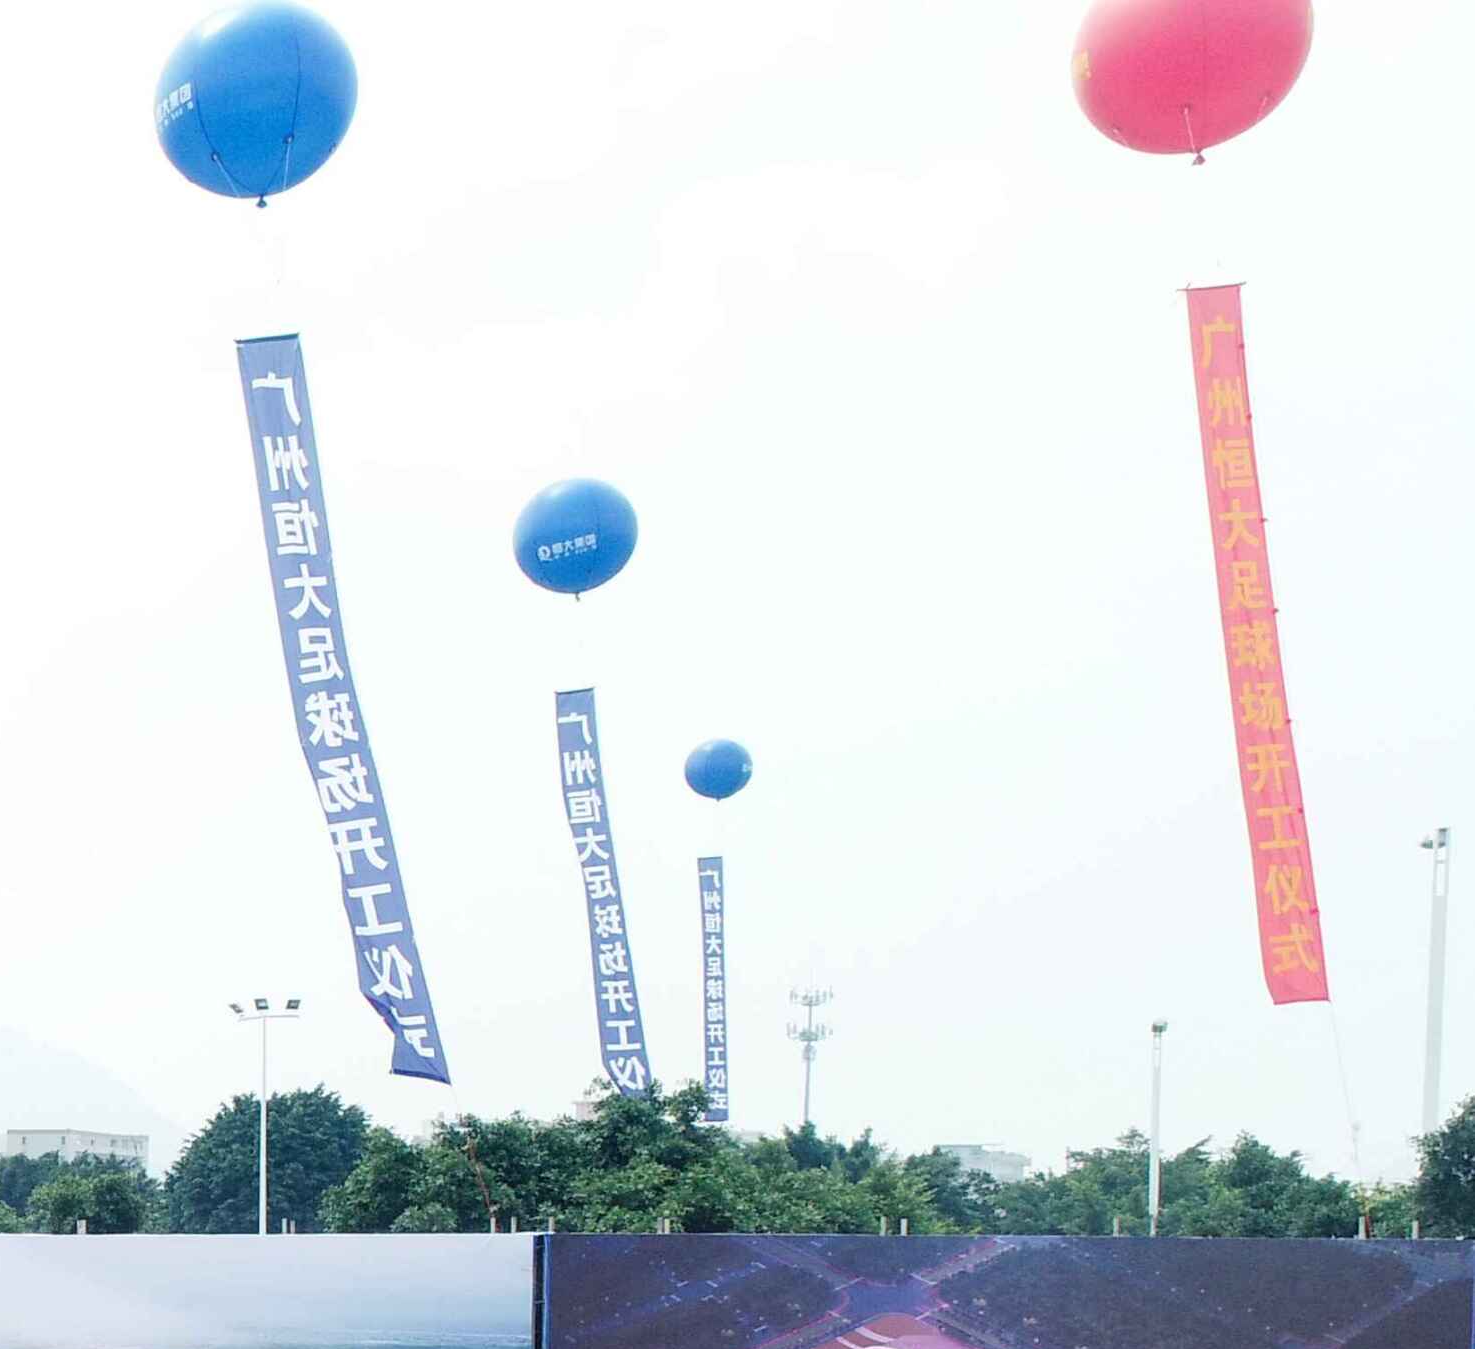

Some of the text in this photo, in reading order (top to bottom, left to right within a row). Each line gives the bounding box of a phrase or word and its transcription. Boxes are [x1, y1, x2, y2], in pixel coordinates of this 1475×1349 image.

[1201, 314, 1320, 975] 广州恒大足球场开工仪式
